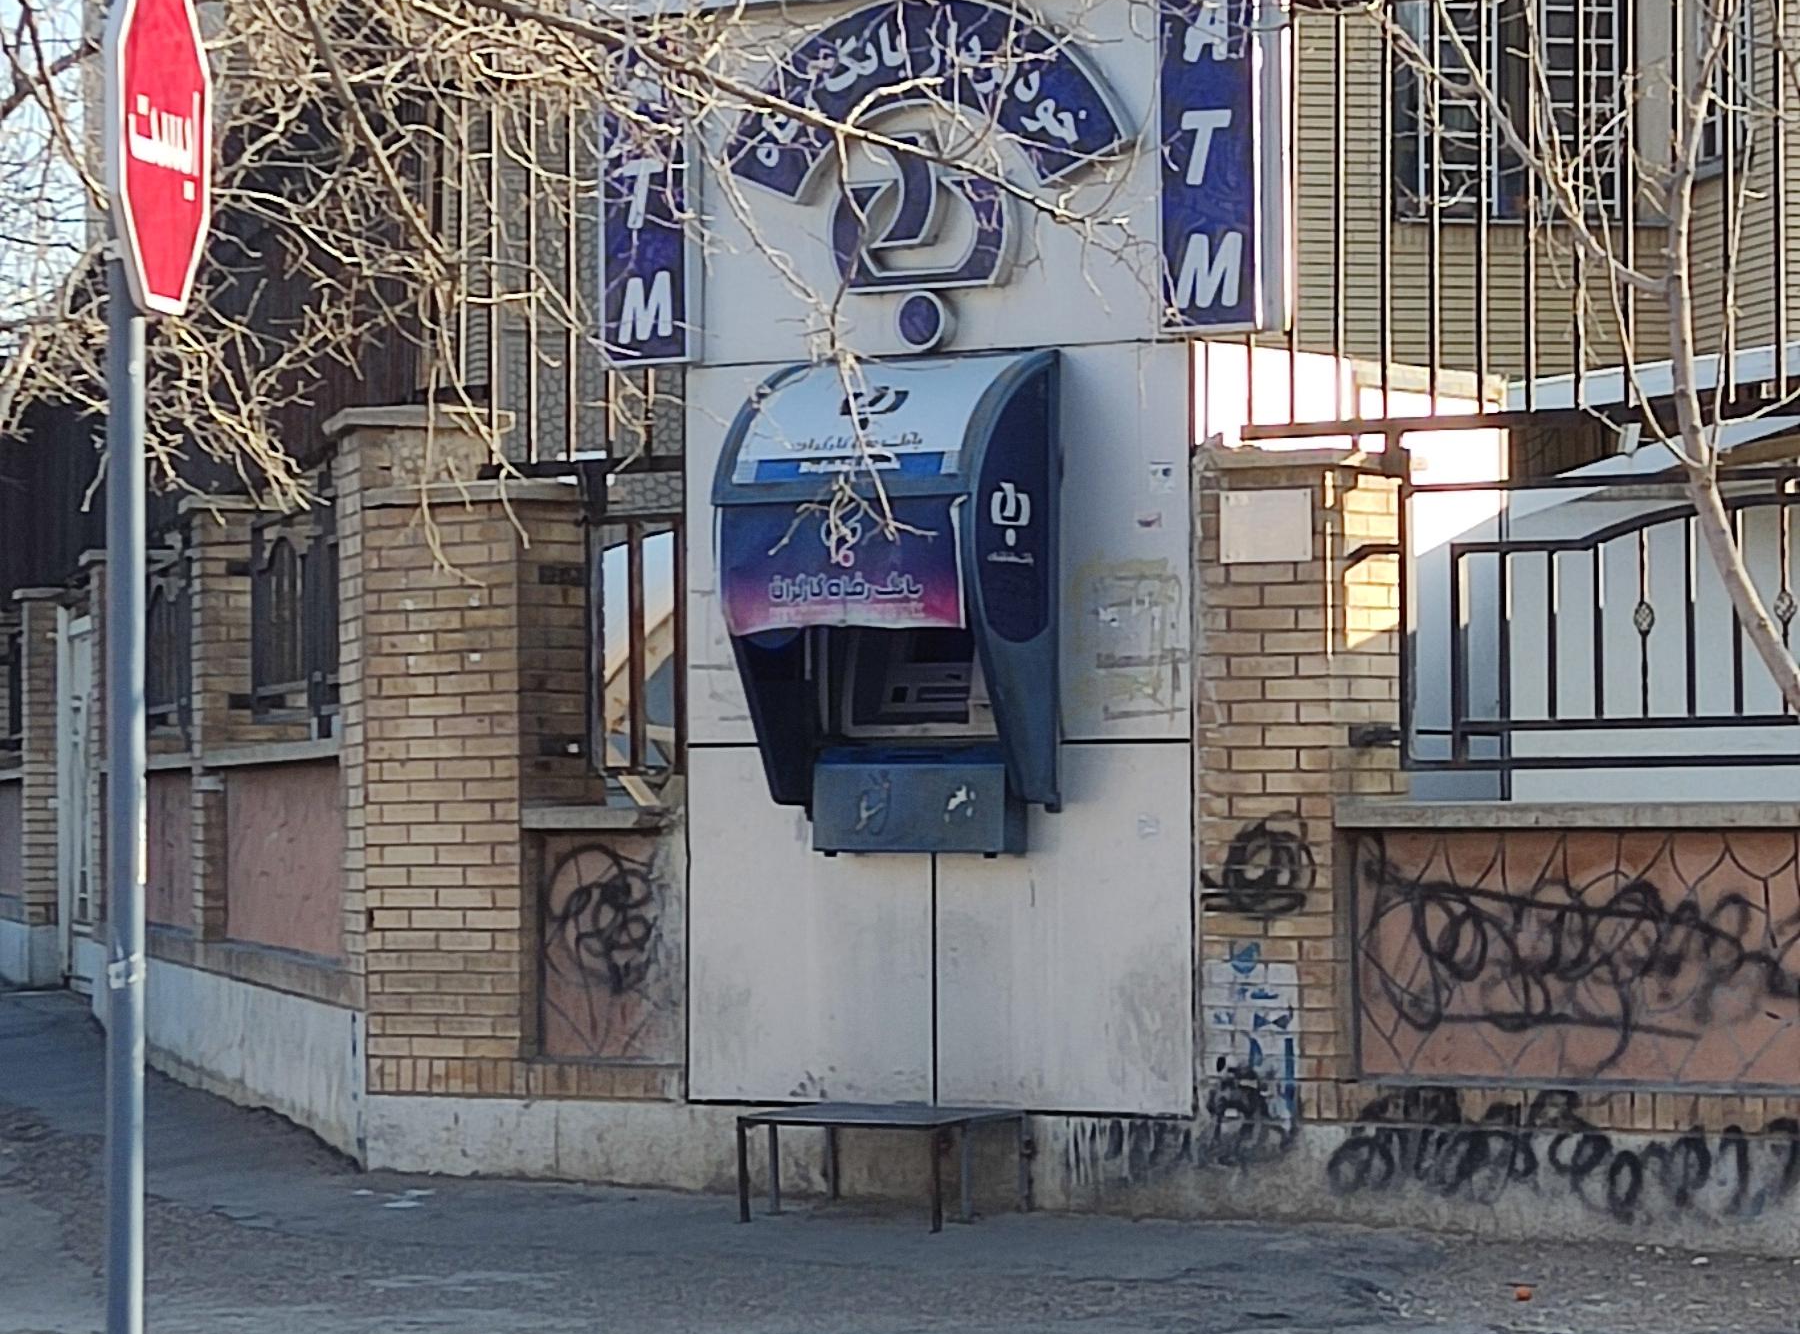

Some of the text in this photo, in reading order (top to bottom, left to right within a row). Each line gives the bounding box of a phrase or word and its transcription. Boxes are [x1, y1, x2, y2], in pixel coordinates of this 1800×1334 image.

[128, 91, 200, 201] ایست
[769, 571, 924, 605] بانک رفاه کارگران
